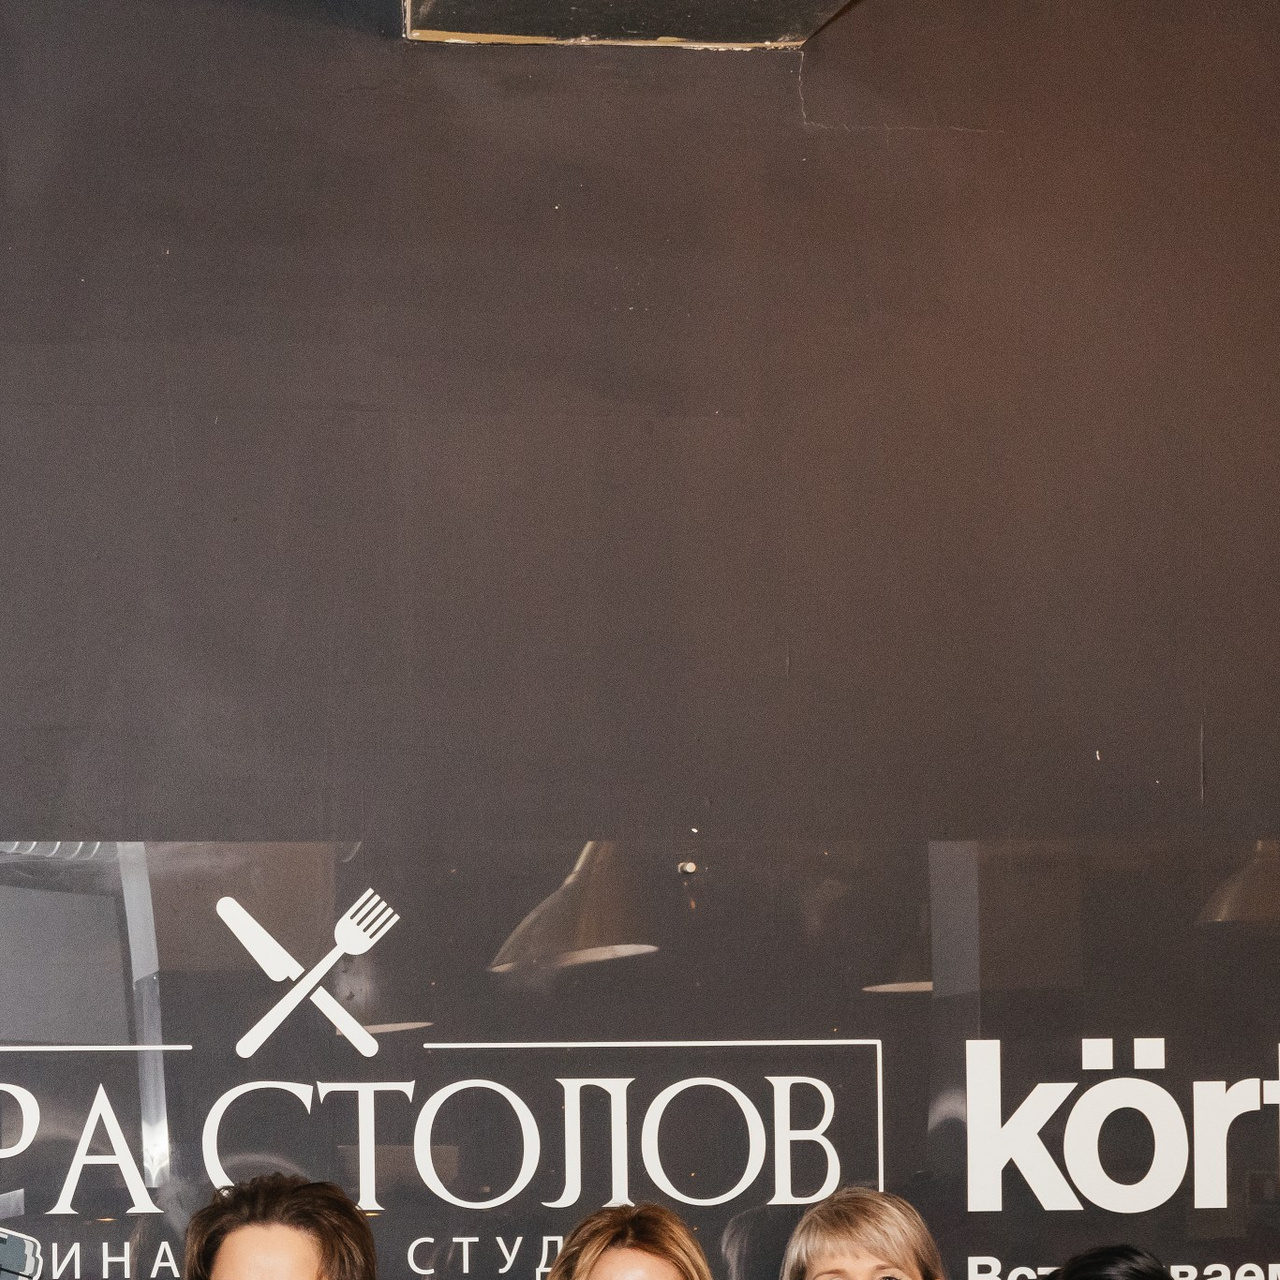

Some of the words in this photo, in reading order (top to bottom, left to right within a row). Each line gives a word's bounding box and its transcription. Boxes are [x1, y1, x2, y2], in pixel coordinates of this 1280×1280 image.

[202, 1076, 842, 1211] СТОЛОВ
[966, 1037, 1280, 1214] kör
[407, 1236, 563, 1280] СТУД
